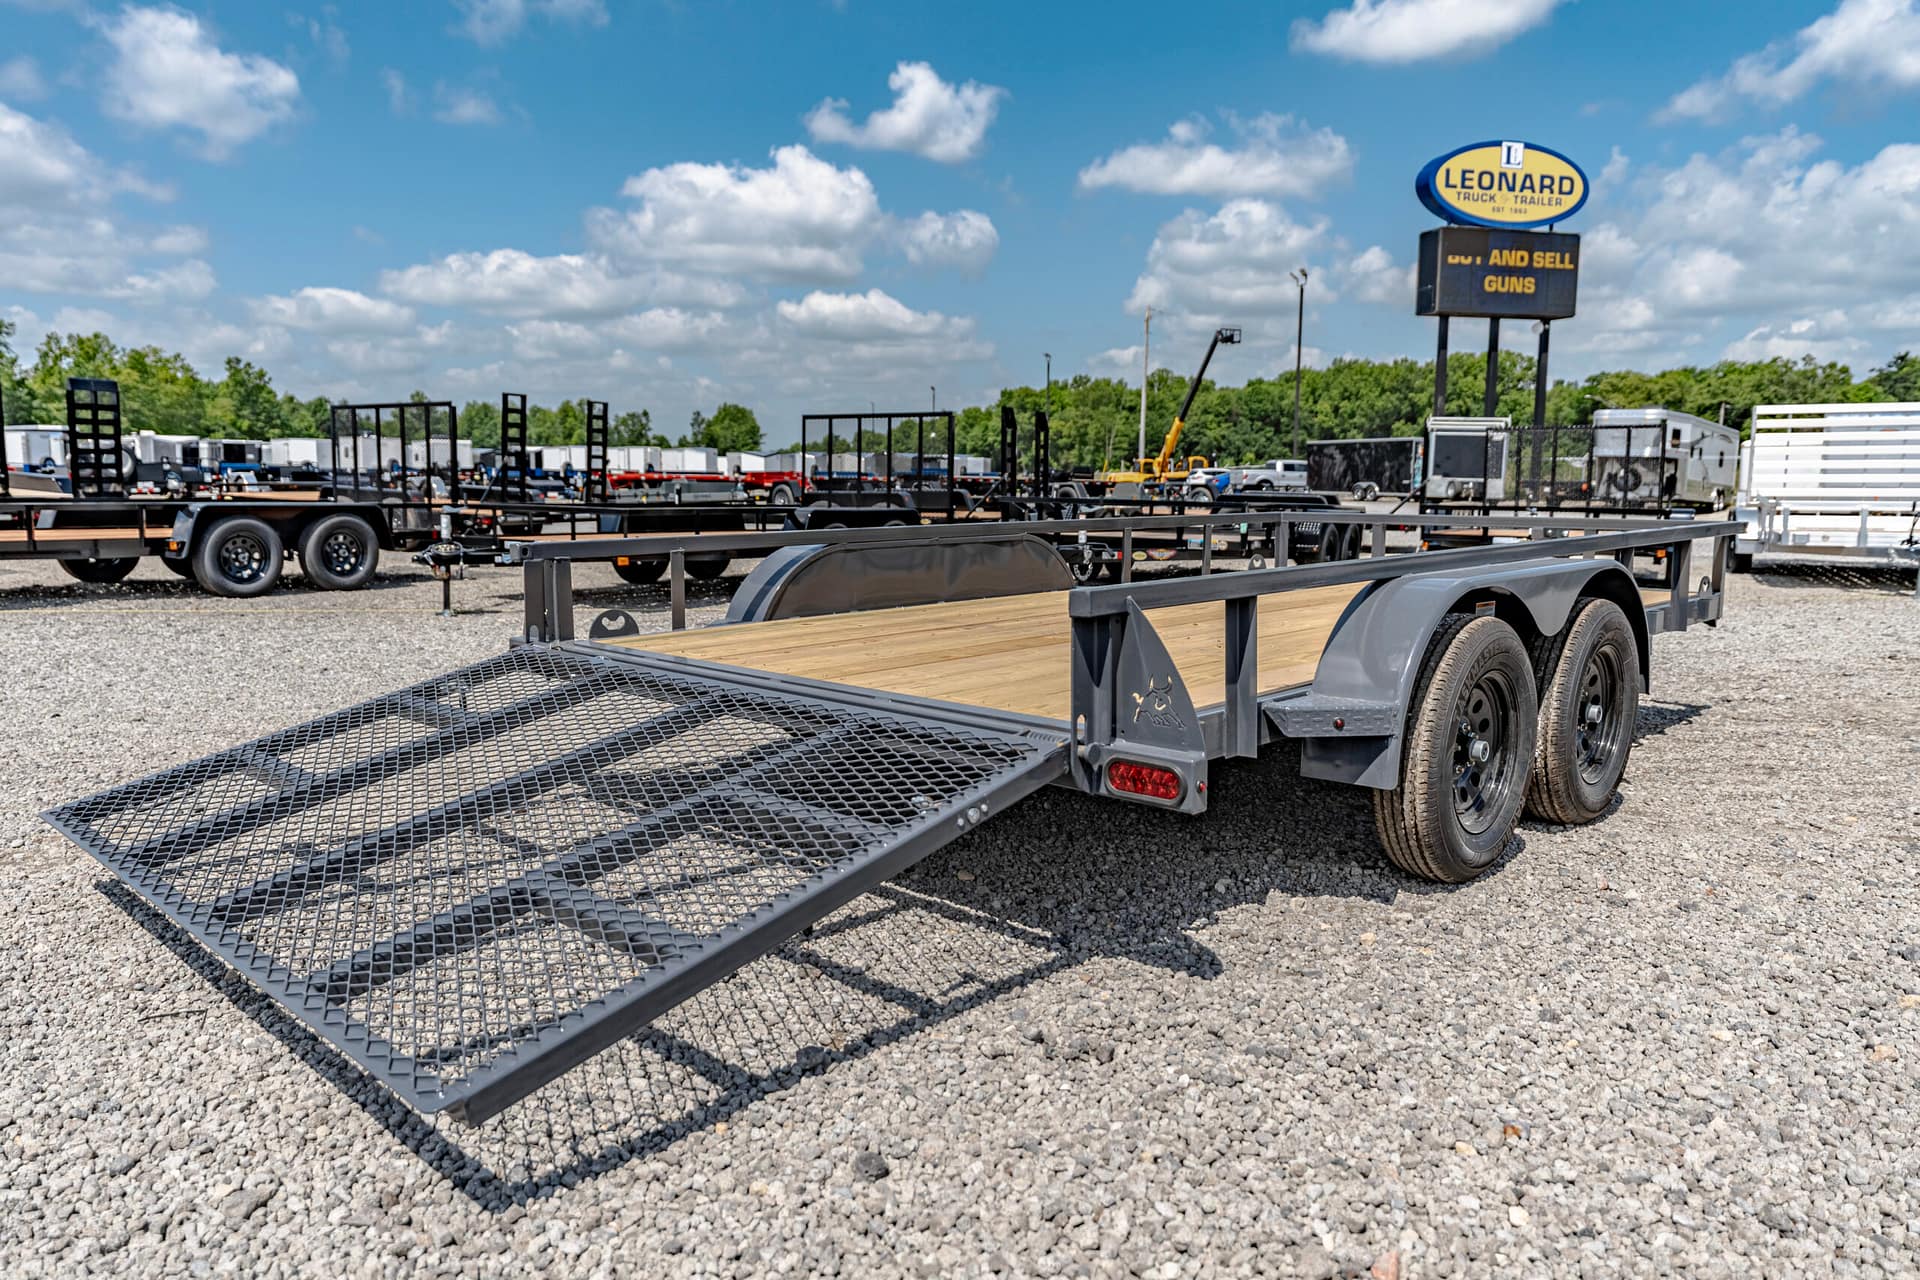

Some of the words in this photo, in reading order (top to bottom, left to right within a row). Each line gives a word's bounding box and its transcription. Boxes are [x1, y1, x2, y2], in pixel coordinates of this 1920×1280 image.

[1444, 168, 1575, 196] LEONARD
[1456, 191, 1497, 203] TRUCK
[1513, 194, 1563, 206] TRAILER
[1488, 249, 1529, 267] AND
[1532, 251, 1575, 269] SELL
[1484, 275, 1536, 294] GUNS
